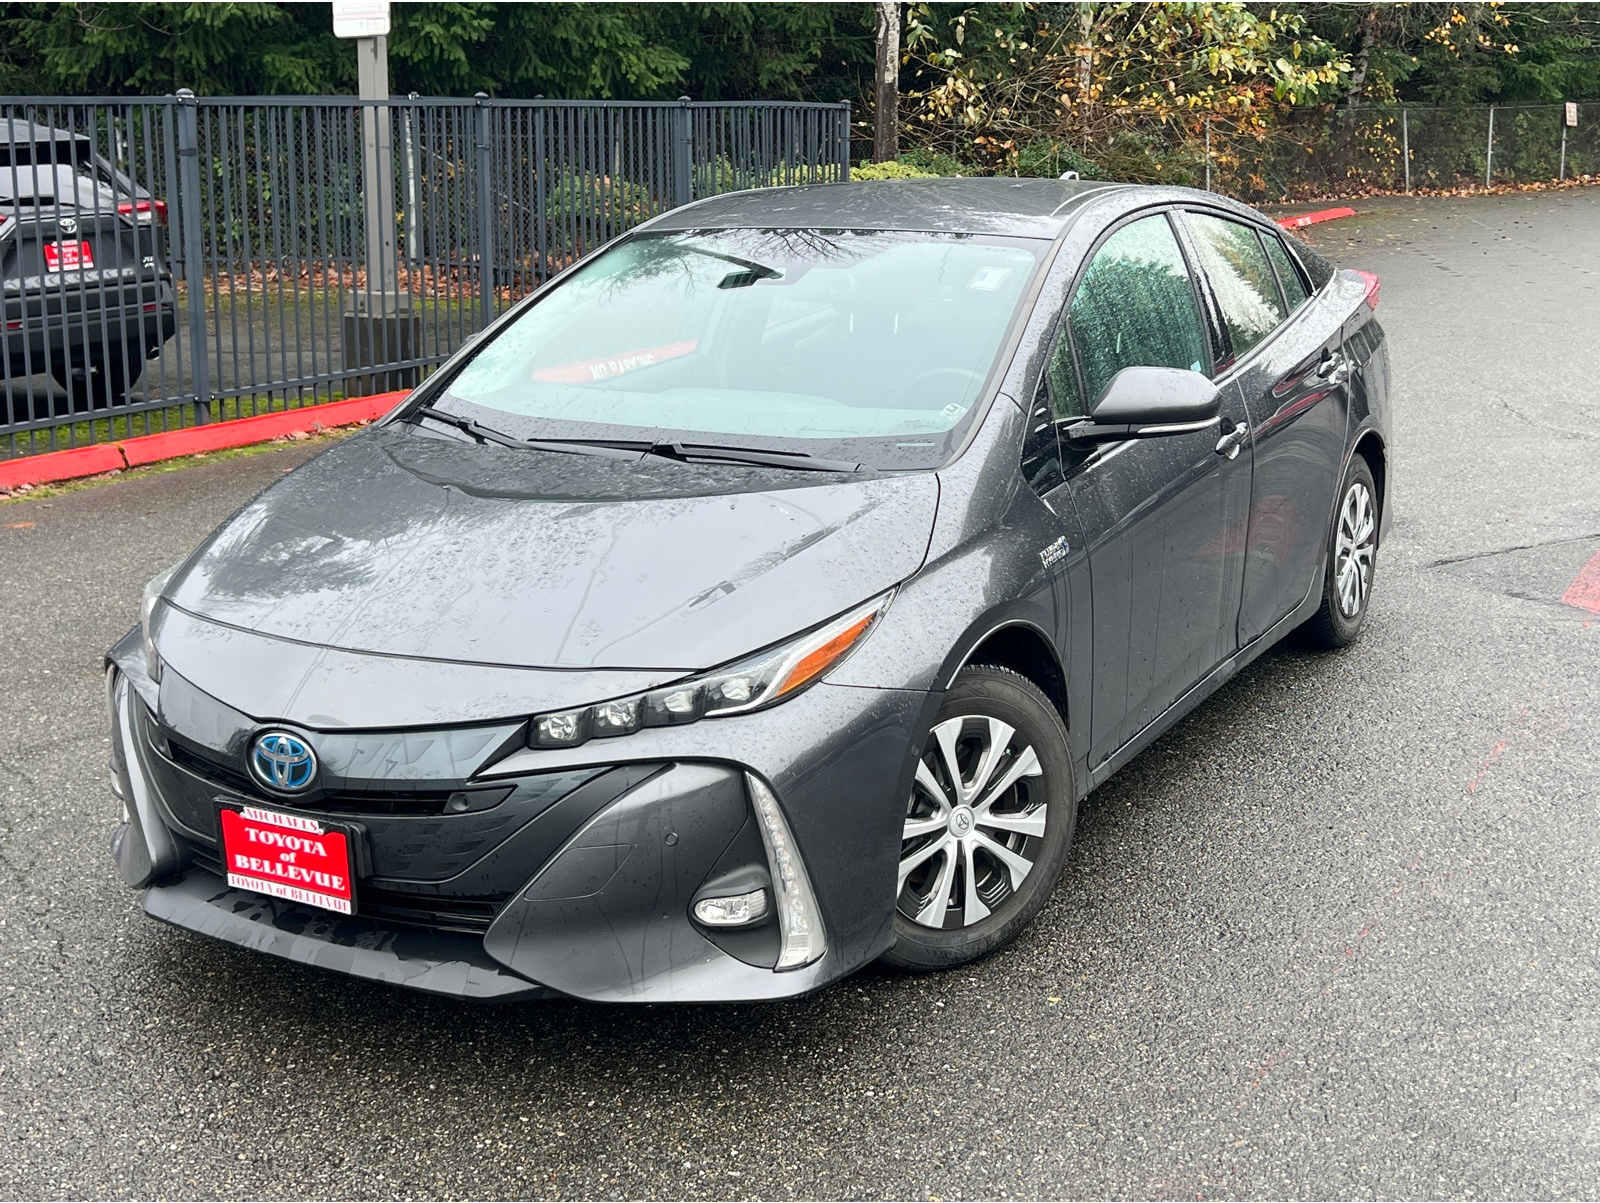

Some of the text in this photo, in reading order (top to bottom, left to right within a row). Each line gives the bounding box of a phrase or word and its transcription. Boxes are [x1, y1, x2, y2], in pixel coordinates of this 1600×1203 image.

[244, 827, 328, 857] TOYOTA
[279, 852, 297, 864] of
[234, 854, 346, 891] BELLEVUE
[230, 875, 273, 894] TOYOTA
[276, 886, 288, 898] of
